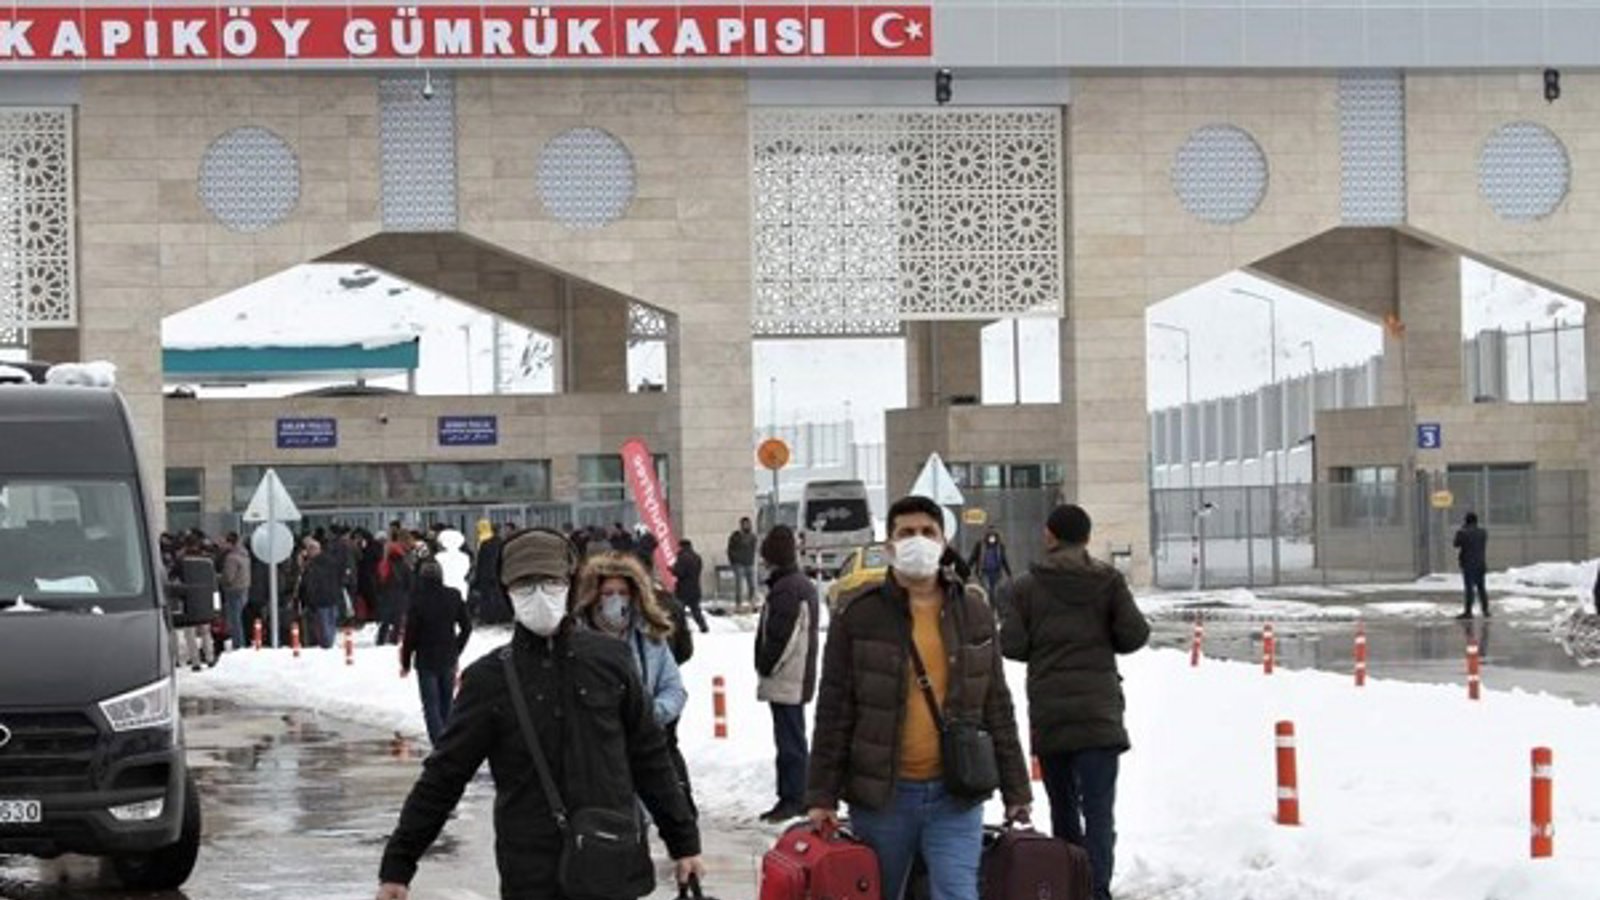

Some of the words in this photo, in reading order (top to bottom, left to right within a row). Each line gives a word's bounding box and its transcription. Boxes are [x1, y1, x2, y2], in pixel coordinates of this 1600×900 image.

[0, 6, 309, 57] KAPIKÖY
[343, 6, 601, 56] GÜMRÜK
[626, 18, 825, 54] KAPISI
[1423, 431, 1435, 447] 3
